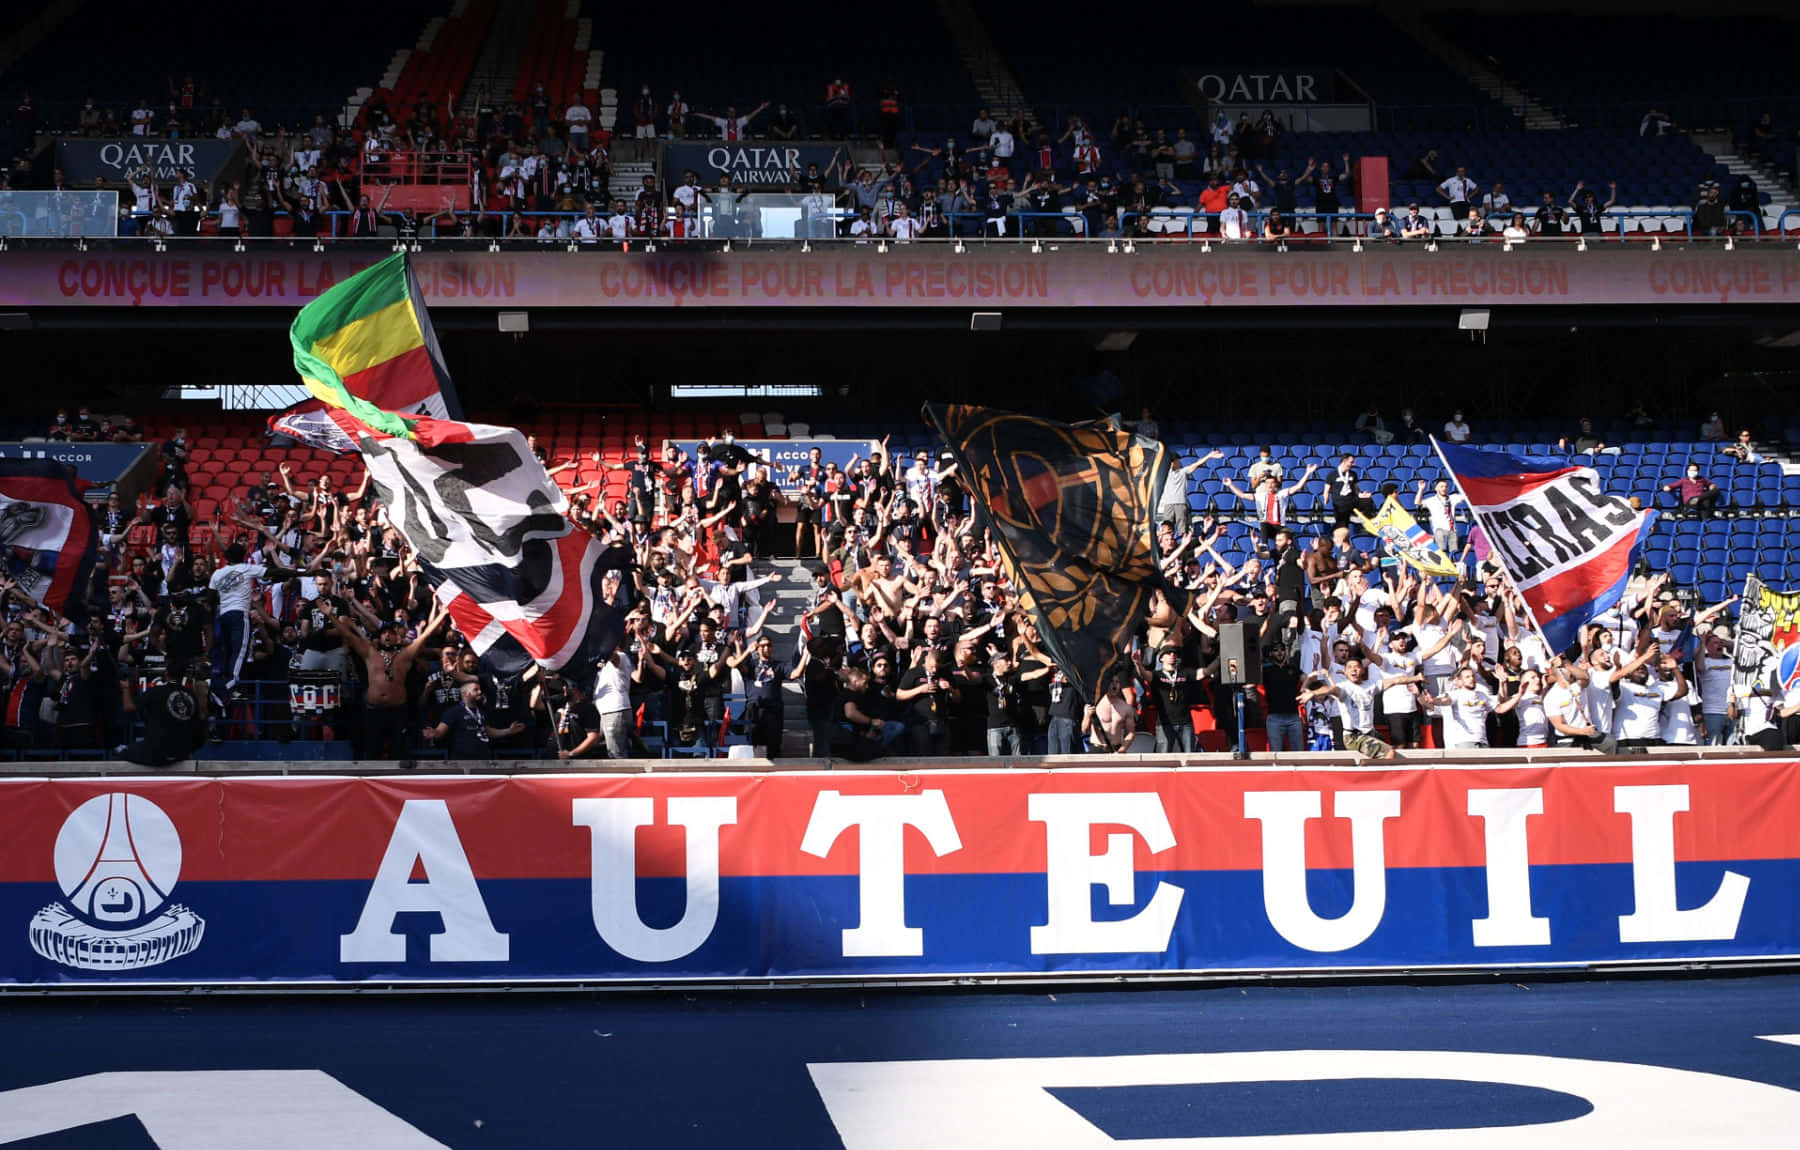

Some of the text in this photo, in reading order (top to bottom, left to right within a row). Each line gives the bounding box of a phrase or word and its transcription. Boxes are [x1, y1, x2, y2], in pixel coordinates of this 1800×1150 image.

[1197, 74, 1319, 105] QATAR
[100, 143, 195, 169] QATAR
[124, 166, 196, 181] AIRWAS
[708, 147, 801, 173] QATAR
[58, 261, 190, 306] CONÇUE
[201, 261, 287, 297] POUR
[296, 261, 336, 297] LA
[600, 253, 1048, 306] CONÇUE POUR LA PRÉCISION
[1130, 261, 1258, 305] CONÇUE
[1269, 261, 1351, 296] POUR
[1361, 261, 1400, 296] LA
[1649, 261, 1772, 304] CONÇUE
[775, 451, 809, 460] ACCO
[340, 784, 1751, 963] AUTEUIL
